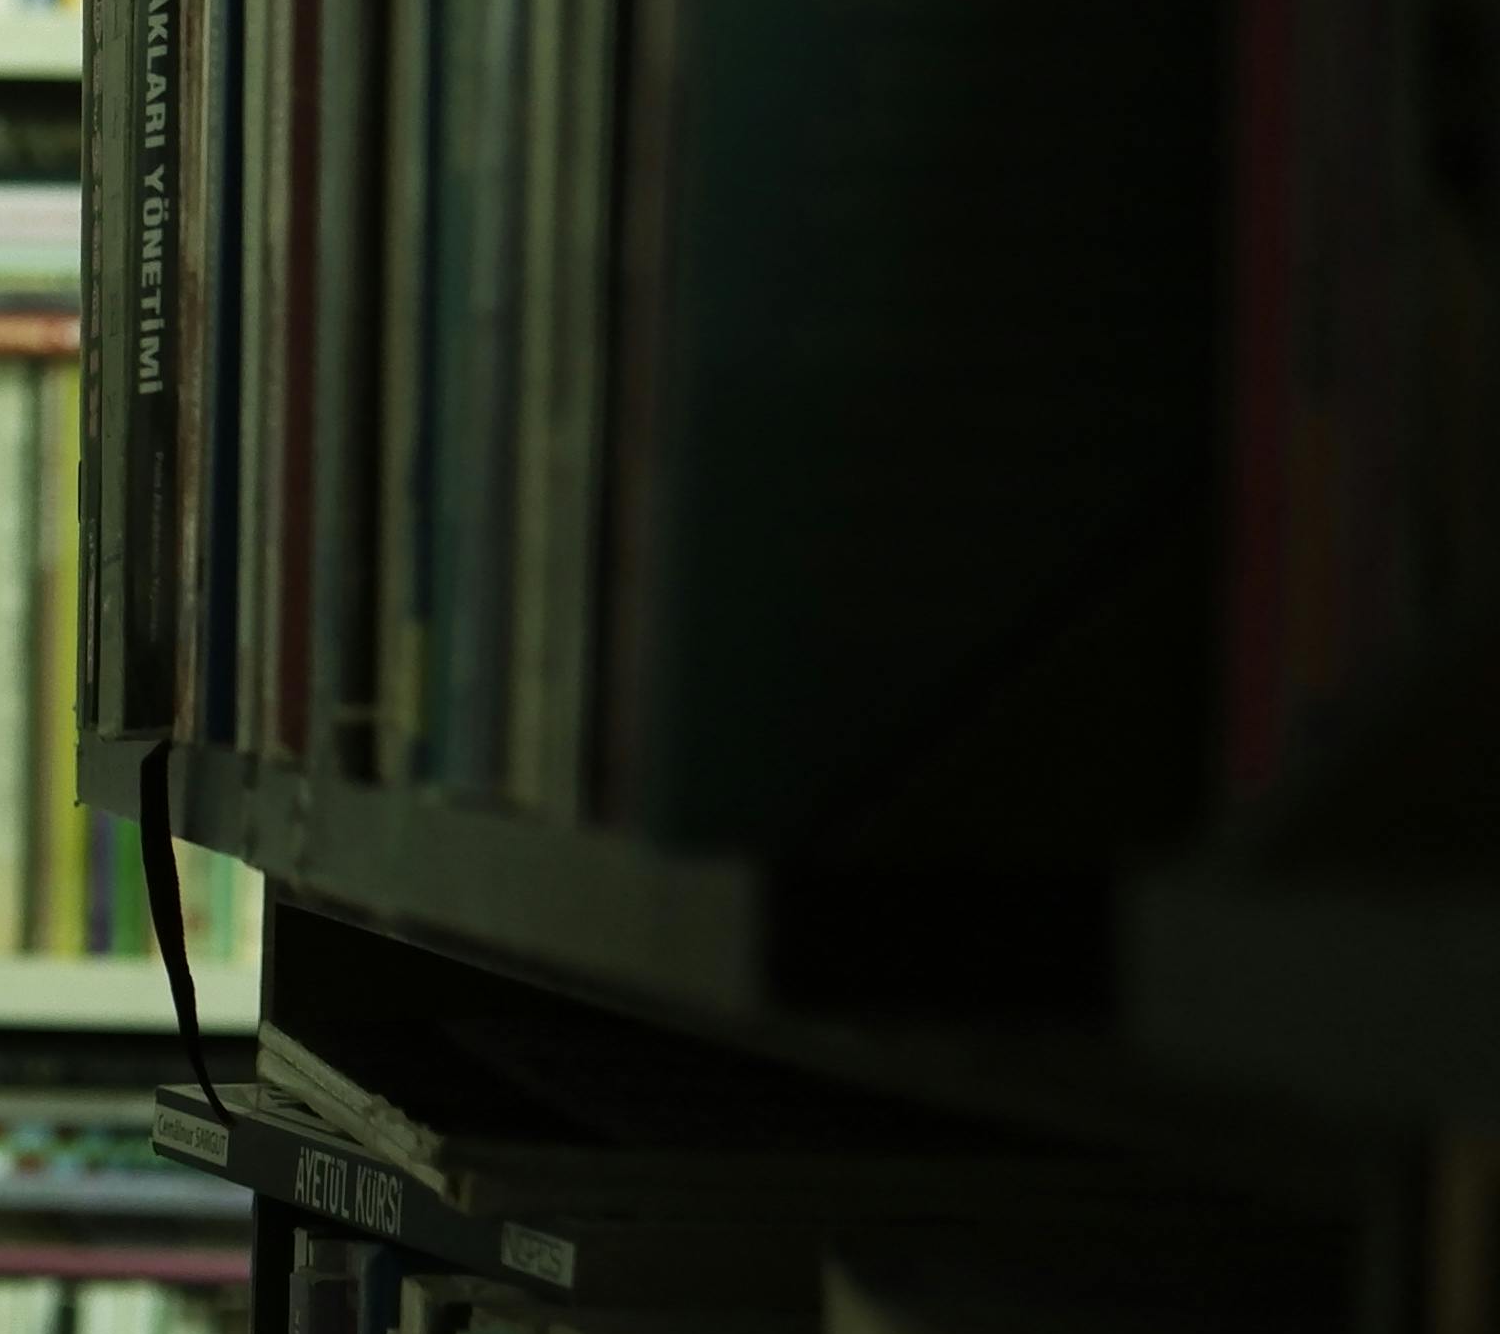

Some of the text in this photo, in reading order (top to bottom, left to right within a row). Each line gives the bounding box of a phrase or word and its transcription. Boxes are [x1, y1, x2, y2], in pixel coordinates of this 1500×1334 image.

[139, 166, 170, 394] YÖNETİMİ
[195, 1124, 228, 1158] SARGUT
[354, 1163, 403, 1237] KÜRSİ
